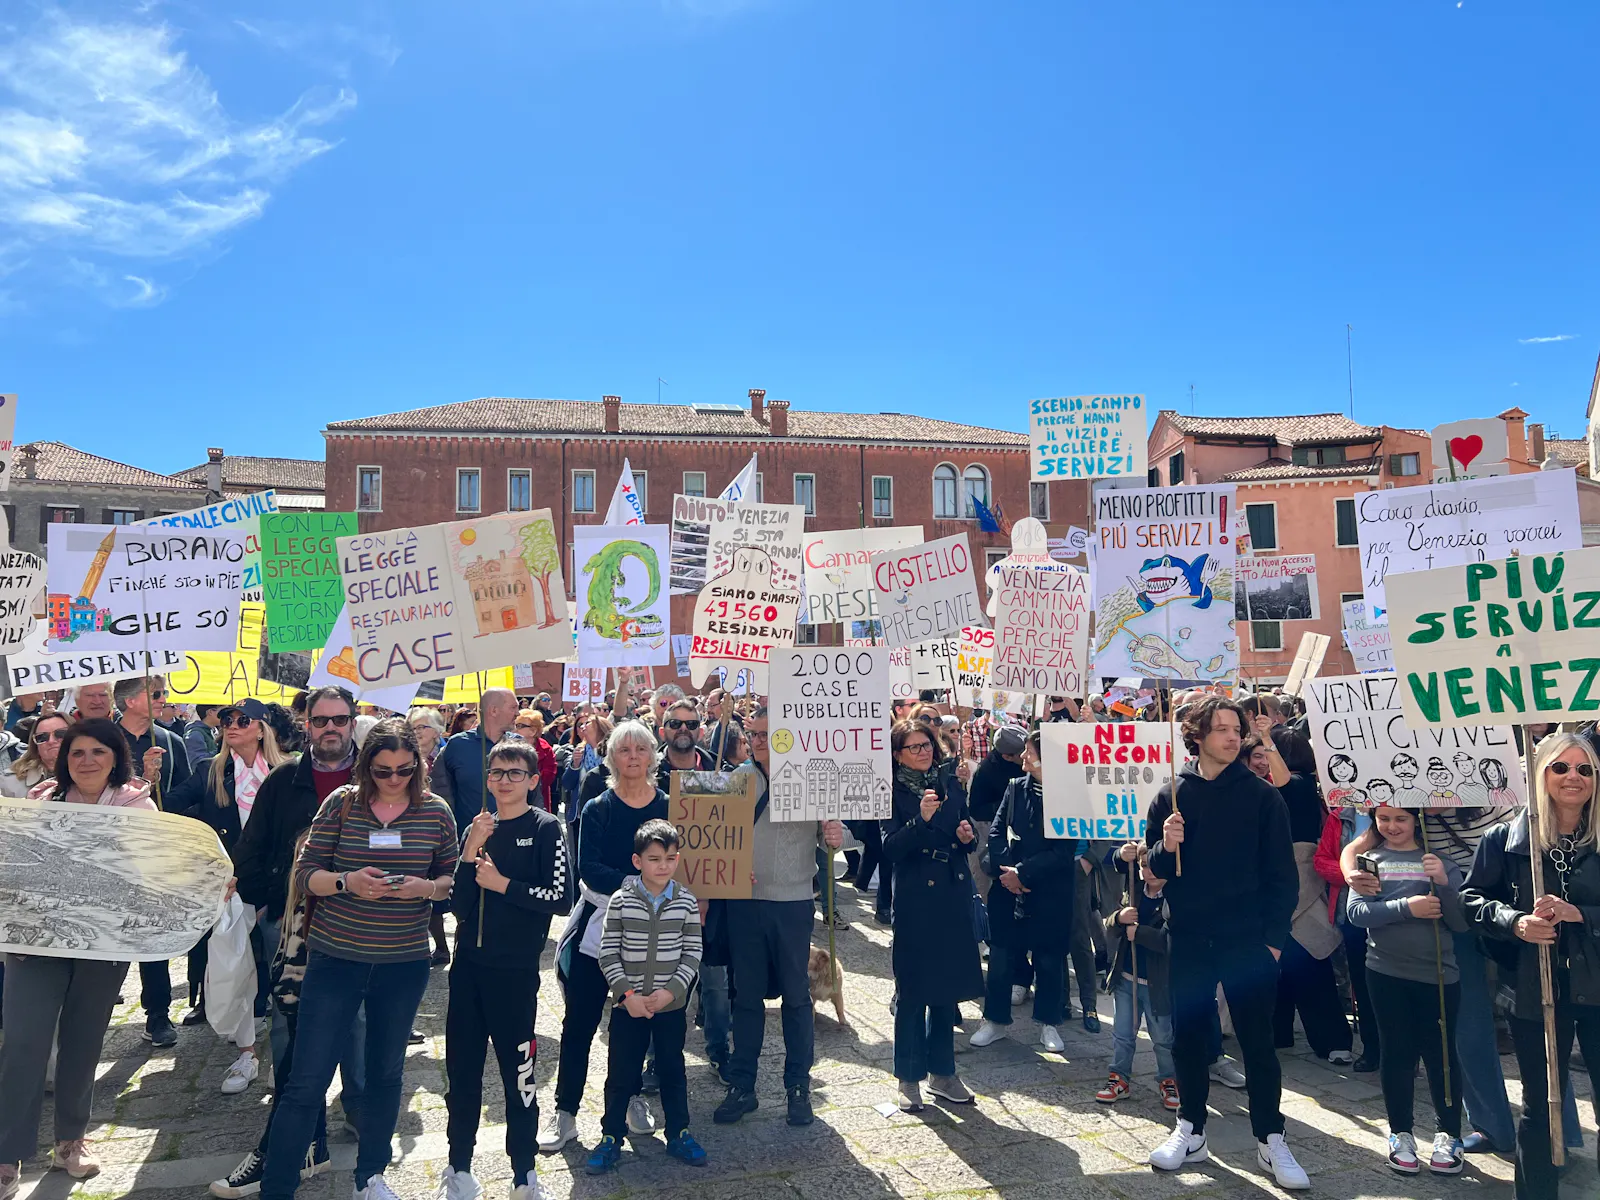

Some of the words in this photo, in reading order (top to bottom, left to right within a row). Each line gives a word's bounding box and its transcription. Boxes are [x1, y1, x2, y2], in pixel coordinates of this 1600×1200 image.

[1031, 398, 1083, 415] SCENDO
[1092, 396, 1141, 410] CAMPO
[1083, 411, 1121, 424] HANNO
[1037, 453, 1133, 478] SERVIZI
[737, 507, 790, 526] VENEZIA
[1098, 495, 1142, 520] MENO
[1146, 491, 1214, 518] PROFITTI
[1360, 493, 1412, 524] Caro
[1423, 490, 1482, 518] diario,
[267, 514, 311, 534] CON
[320, 514, 349, 533] LA
[755, 529, 784, 541] STA
[1136, 521, 1213, 548] SERVIZI
[125, 536, 244, 567] BURANO
[274, 537, 338, 556] LEGG
[350, 537, 387, 551] CON
[396, 531, 418, 545] LA
[1365, 540, 1393, 568] per
[1405, 521, 1488, 551] Venezia
[1503, 520, 1562, 543] vorrei
[345, 545, 417, 574] LEGGE
[875, 543, 968, 593] CASTELLO
[174, 576, 202, 589] STO
[267, 579, 342, 600] VENEZI
[348, 566, 440, 604] SPECIALE
[1002, 569, 1087, 594] VENEZIA
[281, 600, 338, 621] TORN
[999, 589, 1087, 612] CAMMINA
[109, 610, 181, 636] GHE
[352, 601, 454, 630] RESTAURIAMO
[881, 591, 977, 646] PRESENTE
[1008, 609, 1045, 628] CON
[1051, 612, 1079, 630] NOI
[357, 630, 378, 647] LE
[707, 620, 794, 640] RESIDENTI
[961, 626, 995, 649] SOS
[358, 632, 456, 682] CASE
[691, 635, 778, 660] RESILIENT
[997, 644, 1077, 670] VENEZIA
[1367, 648, 1392, 662] CIT
[12, 649, 180, 688] PRESENTE
[791, 652, 873, 677] 2.000
[801, 680, 859, 697] CASE
[995, 664, 1049, 691] SIAMO
[1055, 670, 1081, 693] NOI
[1407, 658, 1600, 722] VENEZ
[1310, 677, 1402, 713] VENEZ
[782, 701, 882, 719] PUBBLICHE
[798, 728, 884, 753] VUOTE
[1094, 724, 1136, 744] NO
[1323, 716, 1378, 750] CHI
[1085, 766, 1154, 785] FERRO
[708, 804, 725, 821] AI
[676, 824, 743, 851] BOSCHI
[683, 858, 736, 886] VERI
